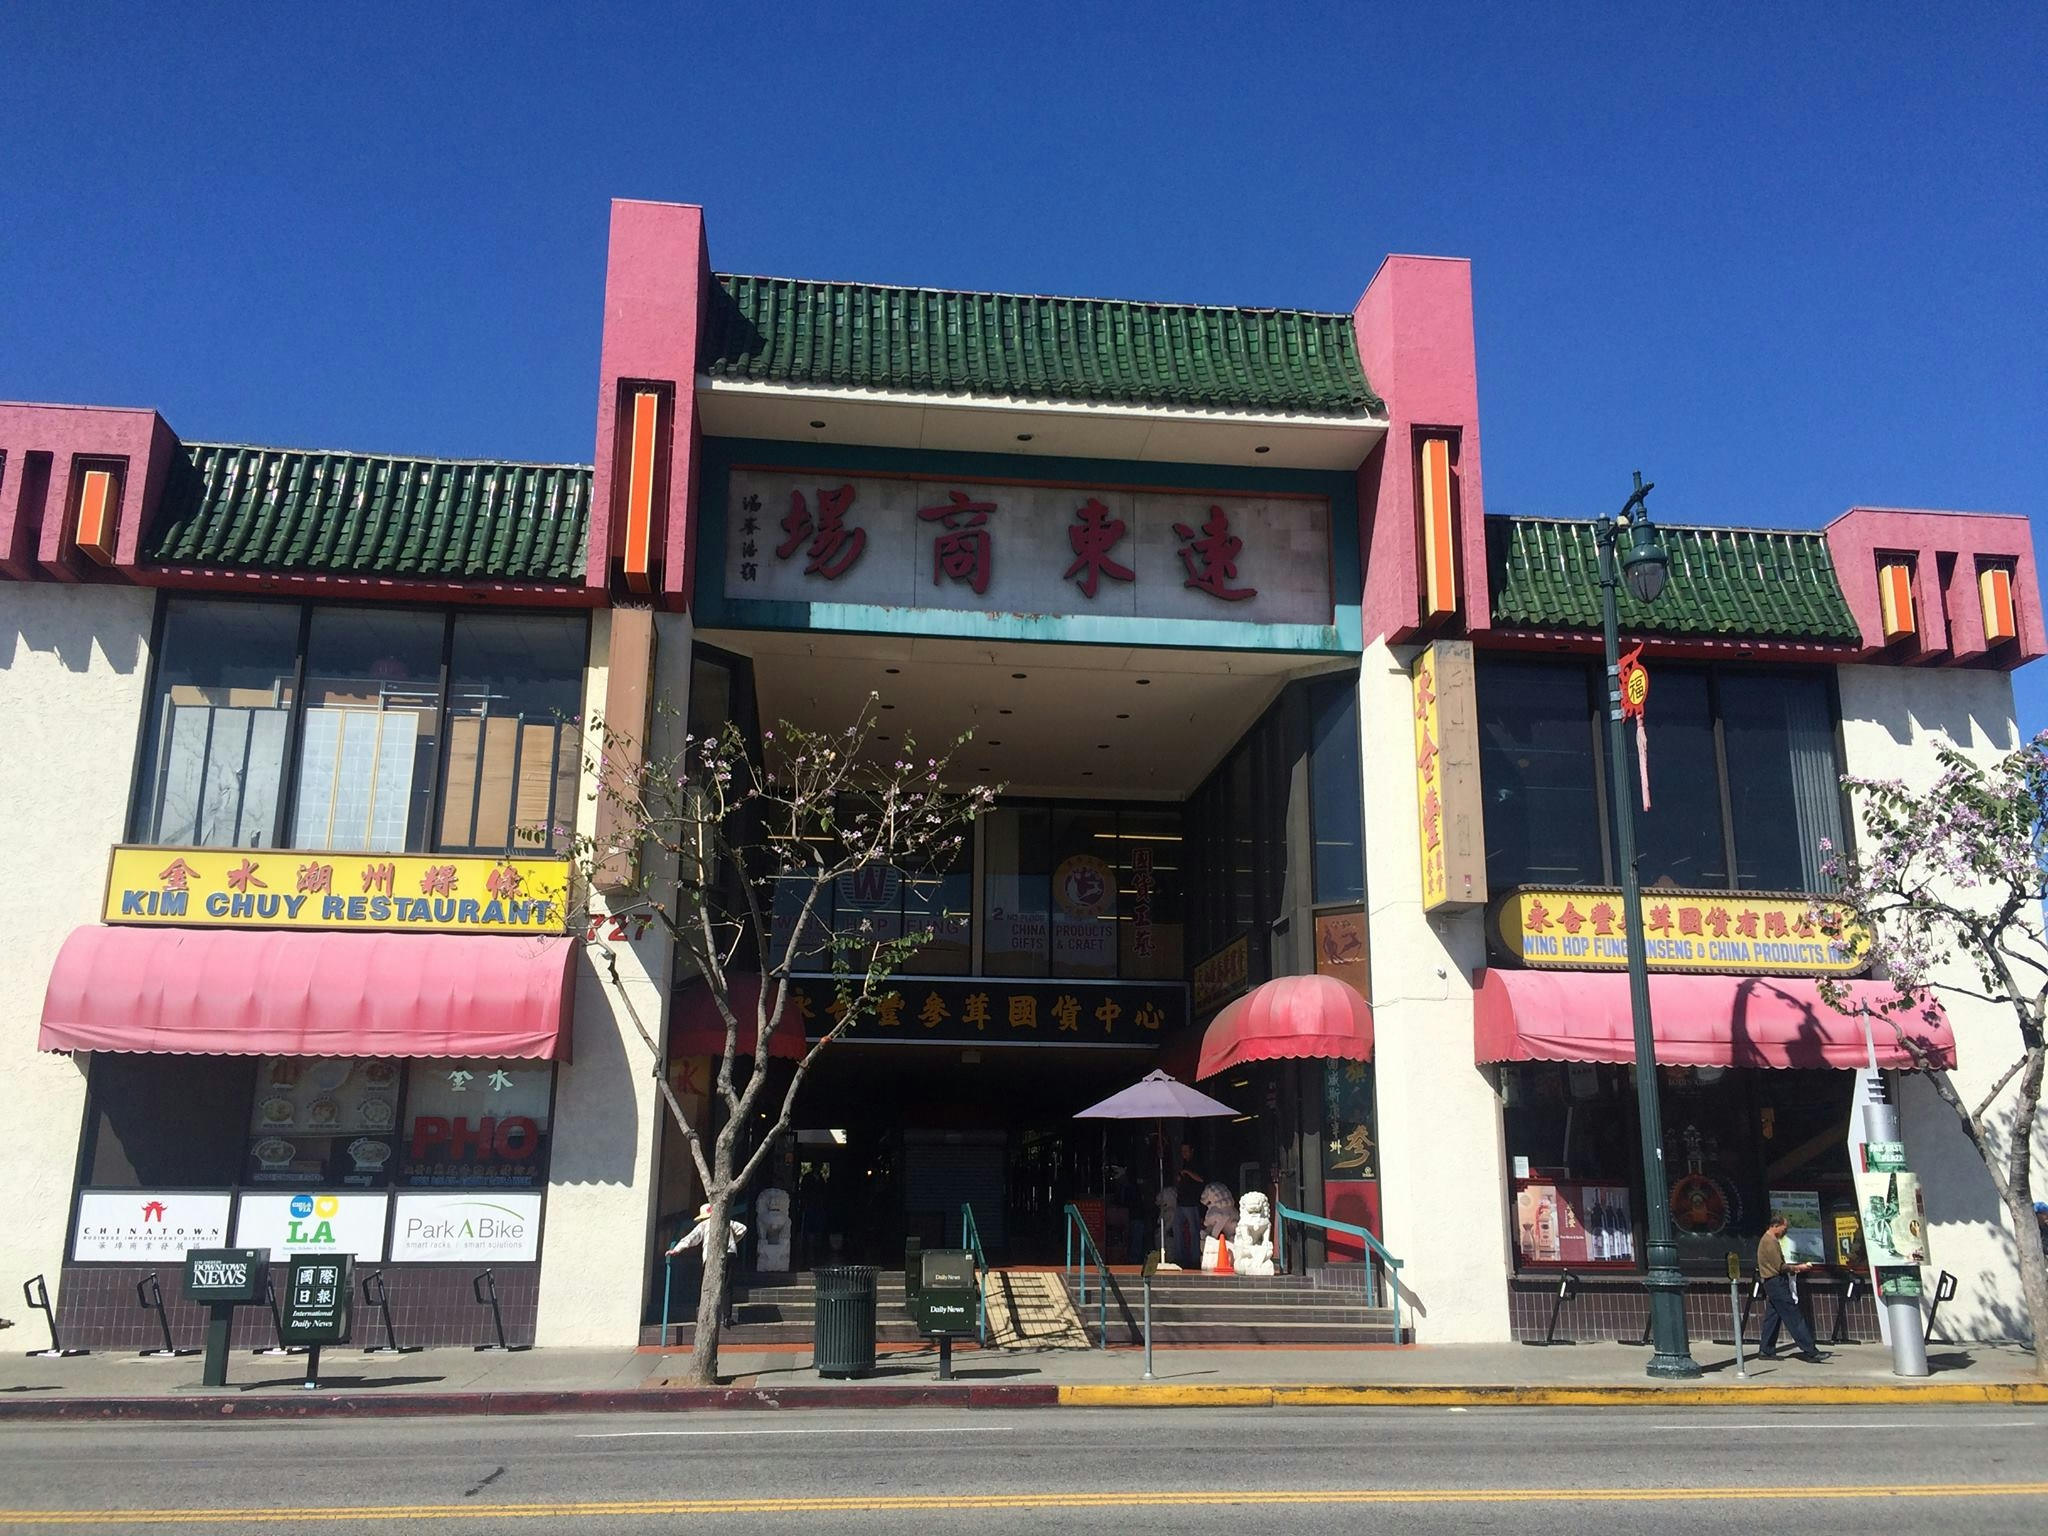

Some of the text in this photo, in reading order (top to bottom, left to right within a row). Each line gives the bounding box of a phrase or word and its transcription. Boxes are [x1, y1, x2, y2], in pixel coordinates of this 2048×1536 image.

[1629, 674, 1645, 702] 福
[854, 868, 887, 899] W
[122, 890, 552, 925] KIM CHUY RESTAURANT
[587, 914, 653, 941] 727
[1012, 924, 1113, 937] CHINA PRODUCTS
[1012, 937, 1044, 949] GIFTS
[1068, 938, 1105, 950] CRAFT
[1523, 936, 1558, 956] WING
[1562, 937, 1590, 957] HOP
[1697, 942, 1705, 958] &
[1709, 940, 1751, 961] CHINA
[448, 1070, 514, 1091] 金水
[411, 1115, 539, 1160] PHO
[84, 1227, 219, 1236] CHINATOWN
[286, 1221, 336, 1243] LA
[407, 1218, 524, 1239] Park A Bike
[464, 1241, 486, 1249] smart
[192, 1269, 246, 1285] NEWS
[194, 1263, 248, 1271] DOWNTOWN
[930, 1305, 965, 1314] Daily News
[291, 1319, 334, 1329] Daily News
